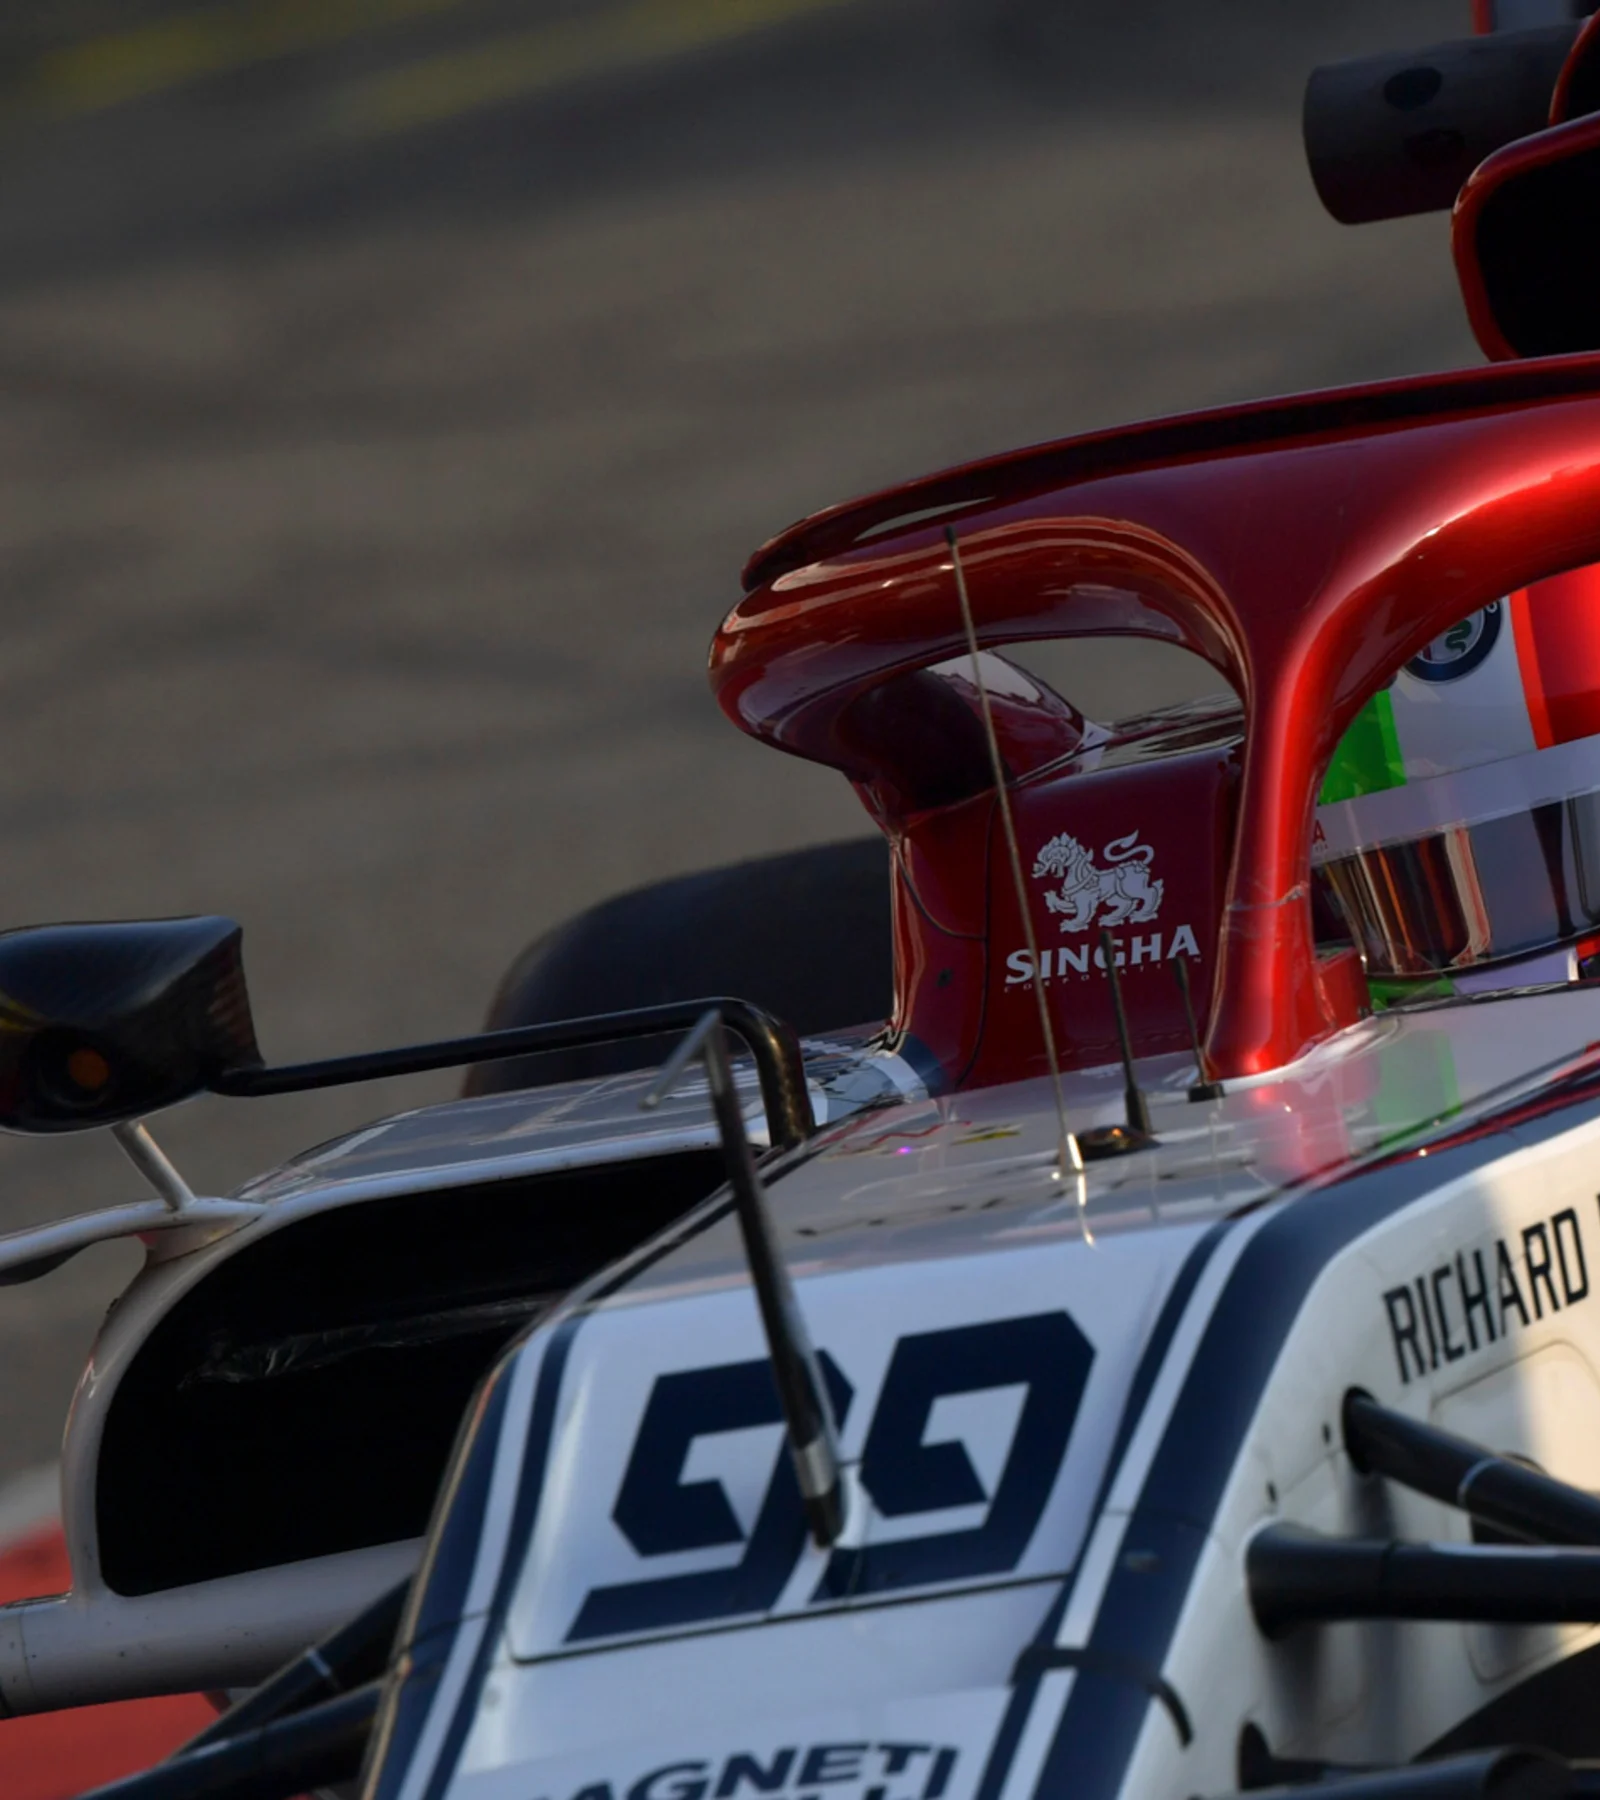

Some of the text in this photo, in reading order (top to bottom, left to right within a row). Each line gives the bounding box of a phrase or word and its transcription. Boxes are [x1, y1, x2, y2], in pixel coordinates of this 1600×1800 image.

[1004, 957, 1201, 993] CORPORATIN
[1005, 923, 1200, 985] SINGHA
[1384, 1208, 1590, 1384] RICHARD
[564, 1310, 1097, 1641] 99
[532, 1743, 958, 1800] GNETI
